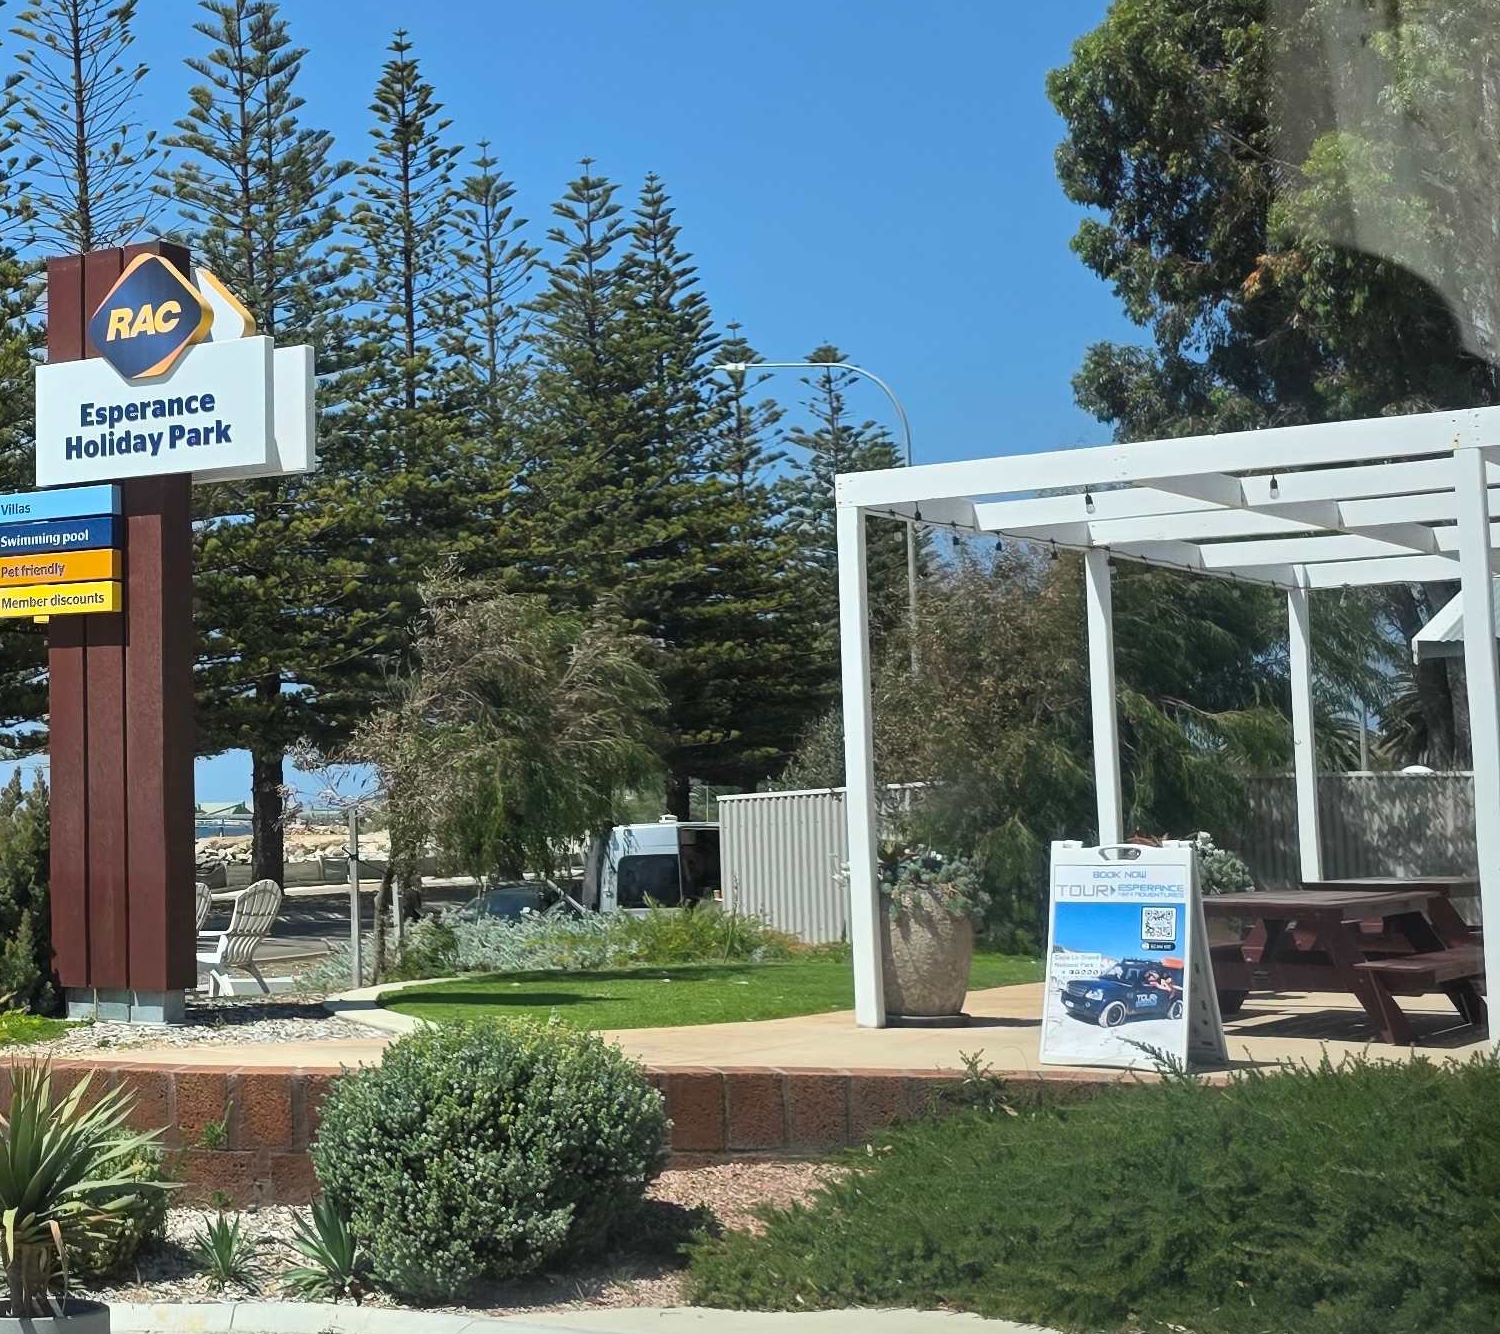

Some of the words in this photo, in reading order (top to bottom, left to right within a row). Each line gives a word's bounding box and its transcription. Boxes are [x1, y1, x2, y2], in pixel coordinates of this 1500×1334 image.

[106, 300, 182, 342] RAC
[80, 393, 216, 429] Esperance
[65, 430, 164, 461] Holiday
[169, 419, 232, 449] Park
[0, 503, 31, 516] Villas
[0, 532, 61, 548] Swimming
[62, 528, 89, 545] pool
[1, 565, 21, 578] Pet
[21, 562, 66, 577] friendly
[1, 596, 48, 610] Member
[50, 592, 105, 607] discounts
[1092, 871, 1121, 879] BOOK
[1124, 870, 1147, 879] NOW
[1055, 884, 1109, 897] TOUR
[1117, 883, 1185, 893] ESPERANCE
